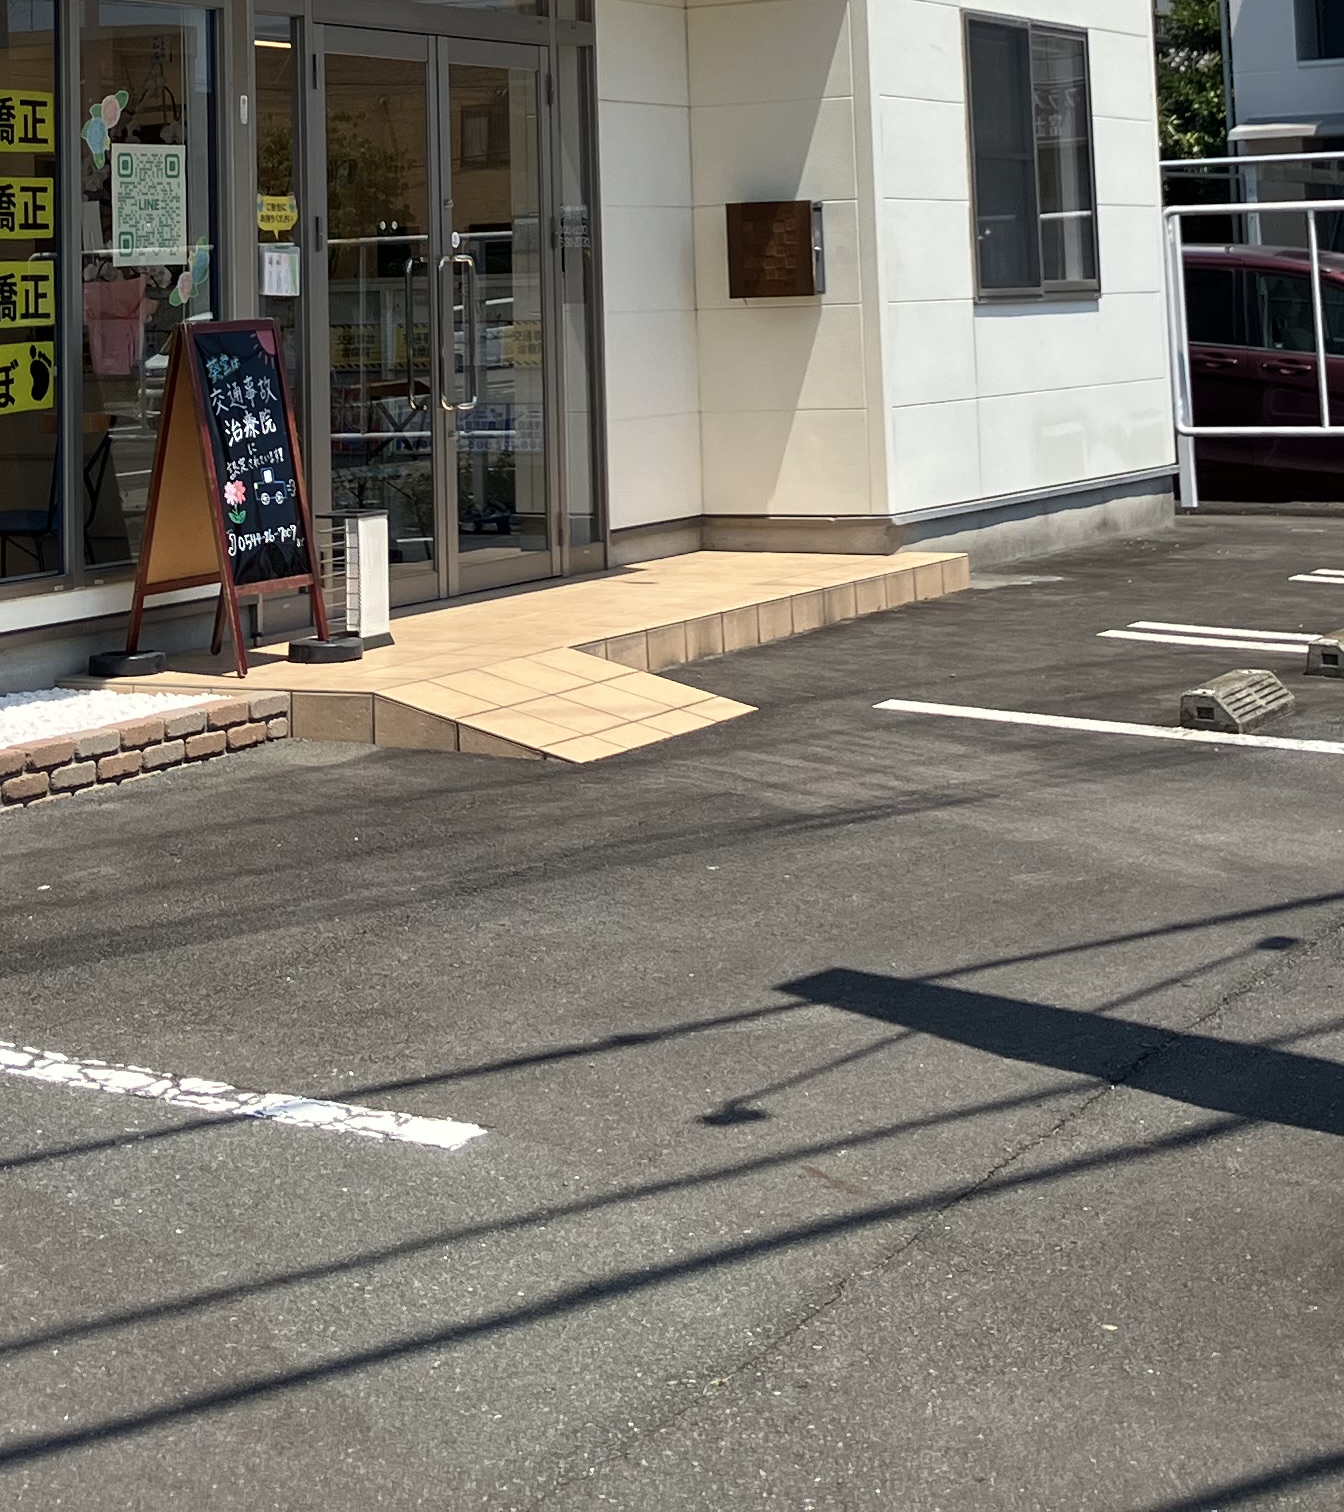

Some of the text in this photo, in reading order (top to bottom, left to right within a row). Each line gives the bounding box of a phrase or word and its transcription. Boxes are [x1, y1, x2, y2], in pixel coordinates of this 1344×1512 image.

[139, 199, 159, 211] LINE
[210, 375, 278, 416] 交通事故
[224, 408, 277, 447] 治療院
[247, 443, 259, 456] に
